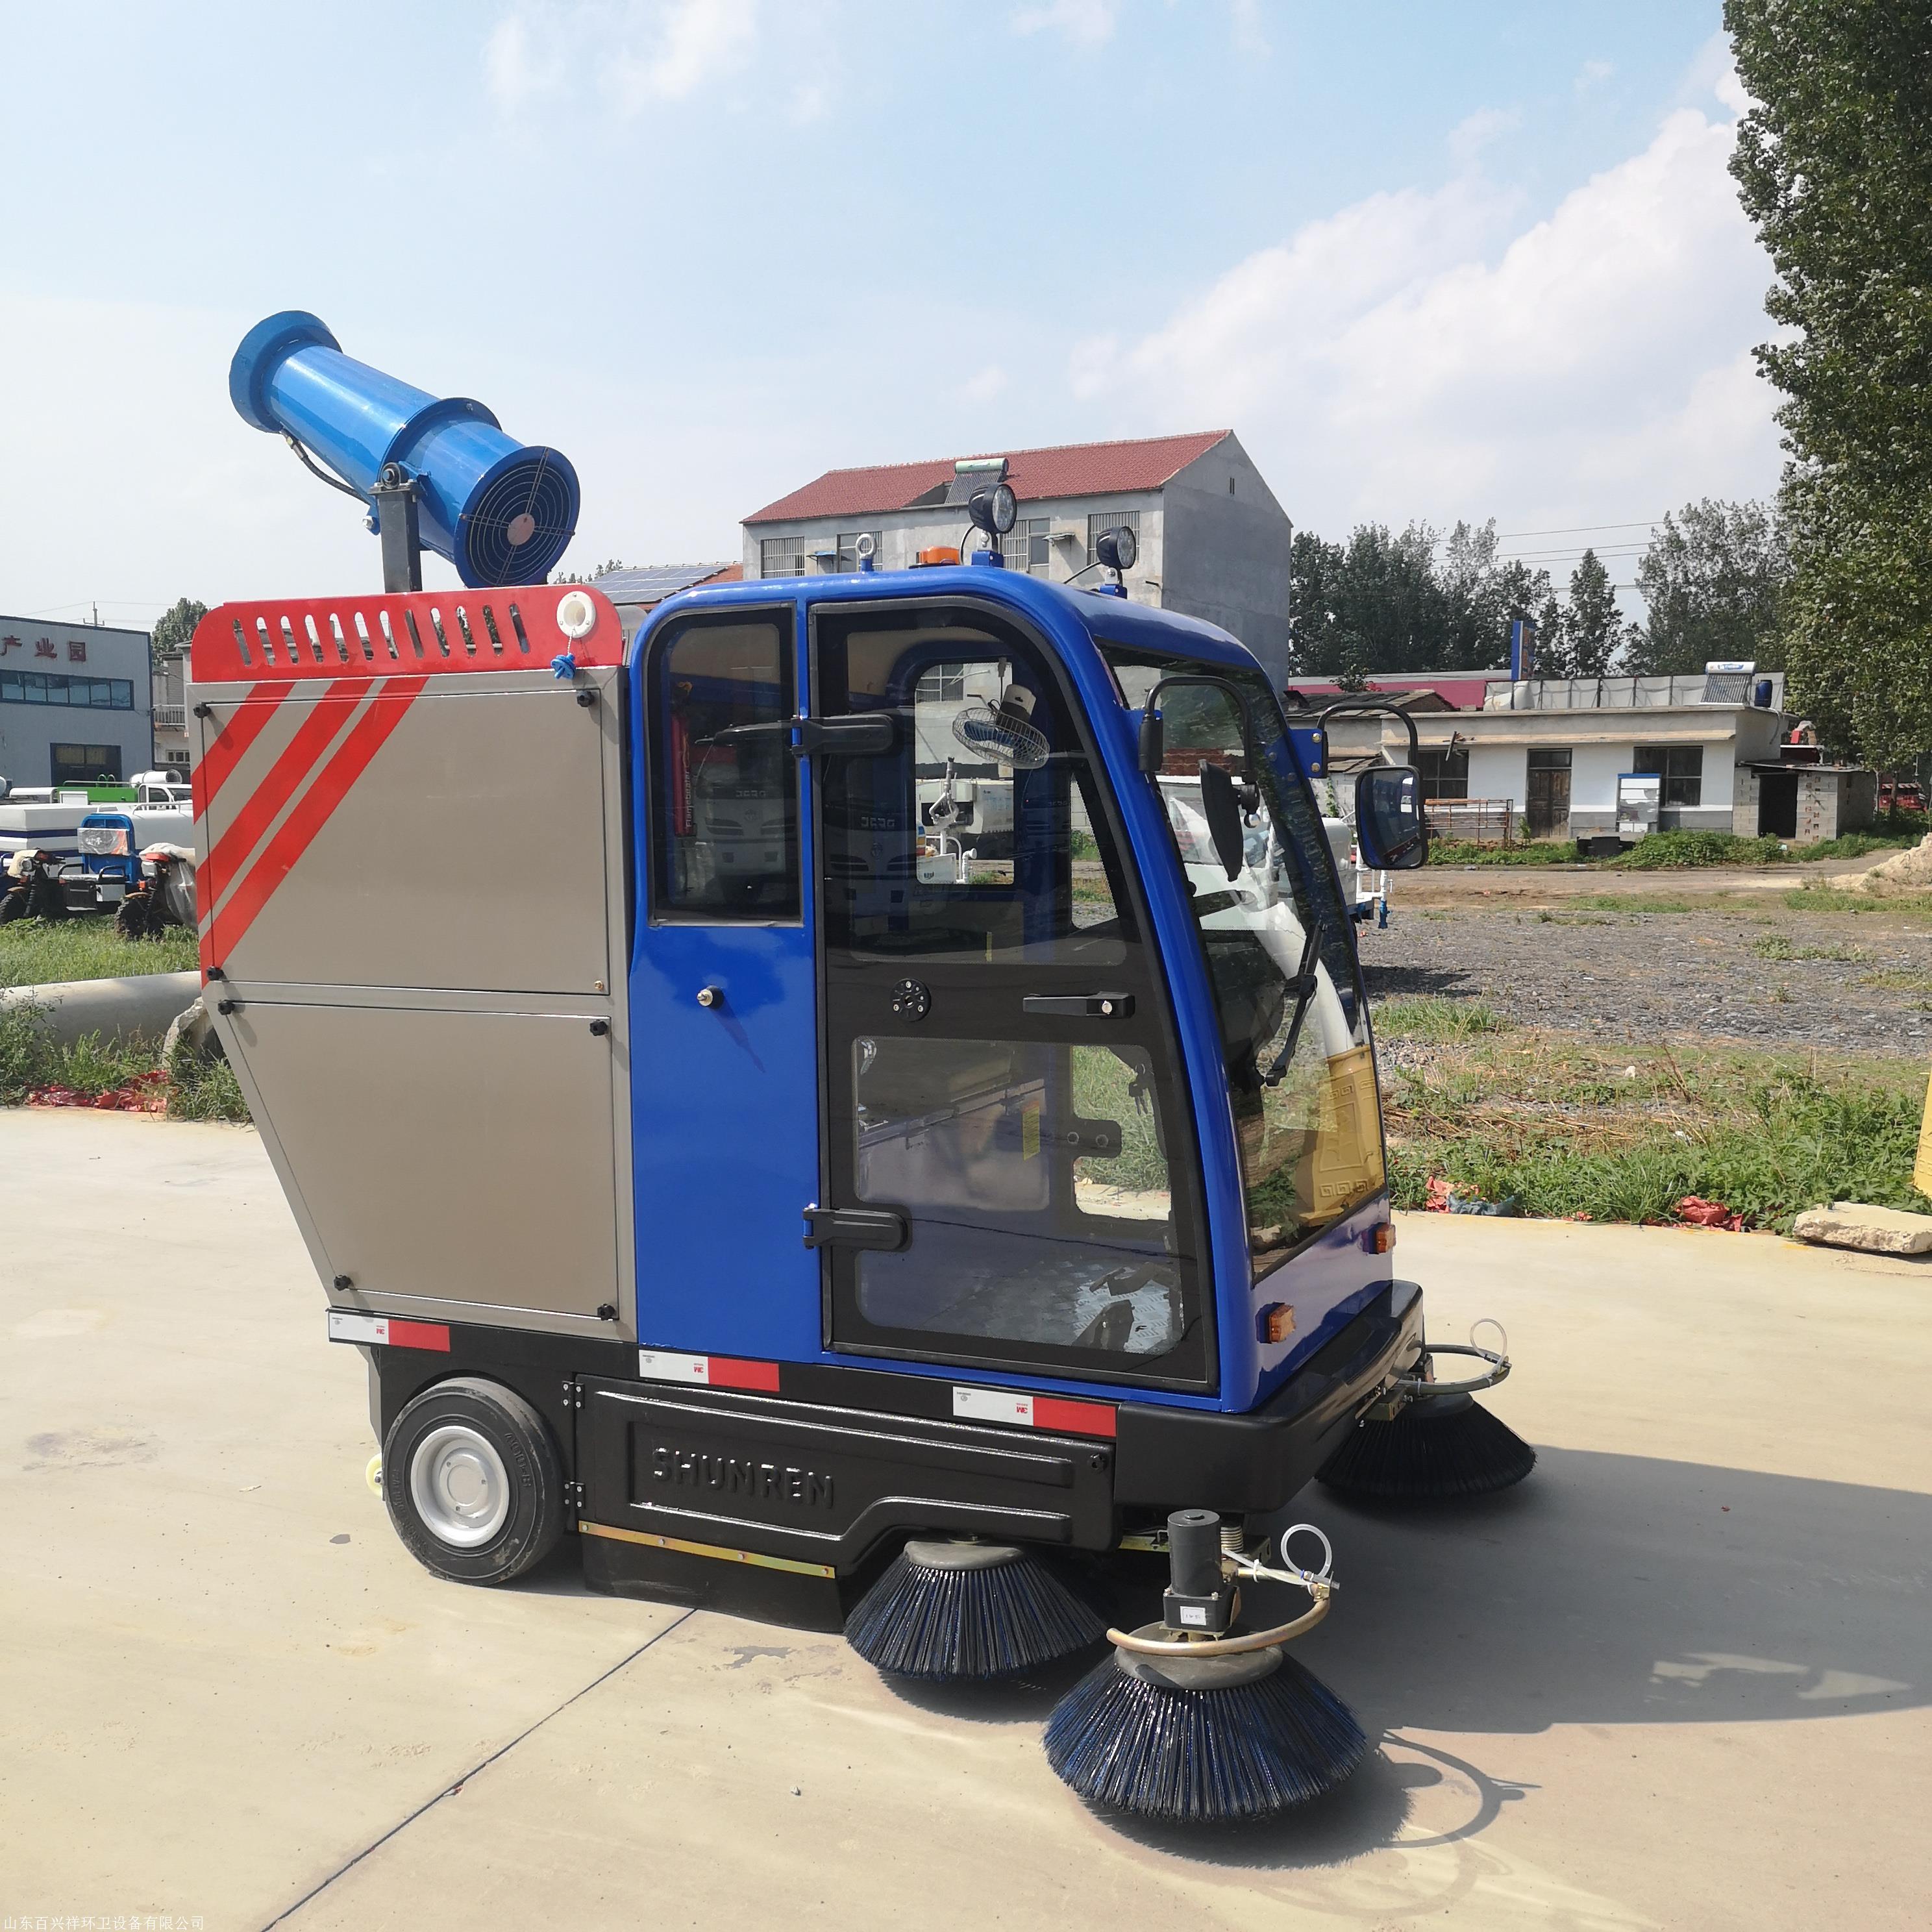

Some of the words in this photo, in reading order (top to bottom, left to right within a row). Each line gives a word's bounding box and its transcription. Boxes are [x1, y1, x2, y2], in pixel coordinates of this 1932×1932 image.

[0, 635, 86, 662] 产业园
[652, 1447, 834, 1509] SHUNREN
